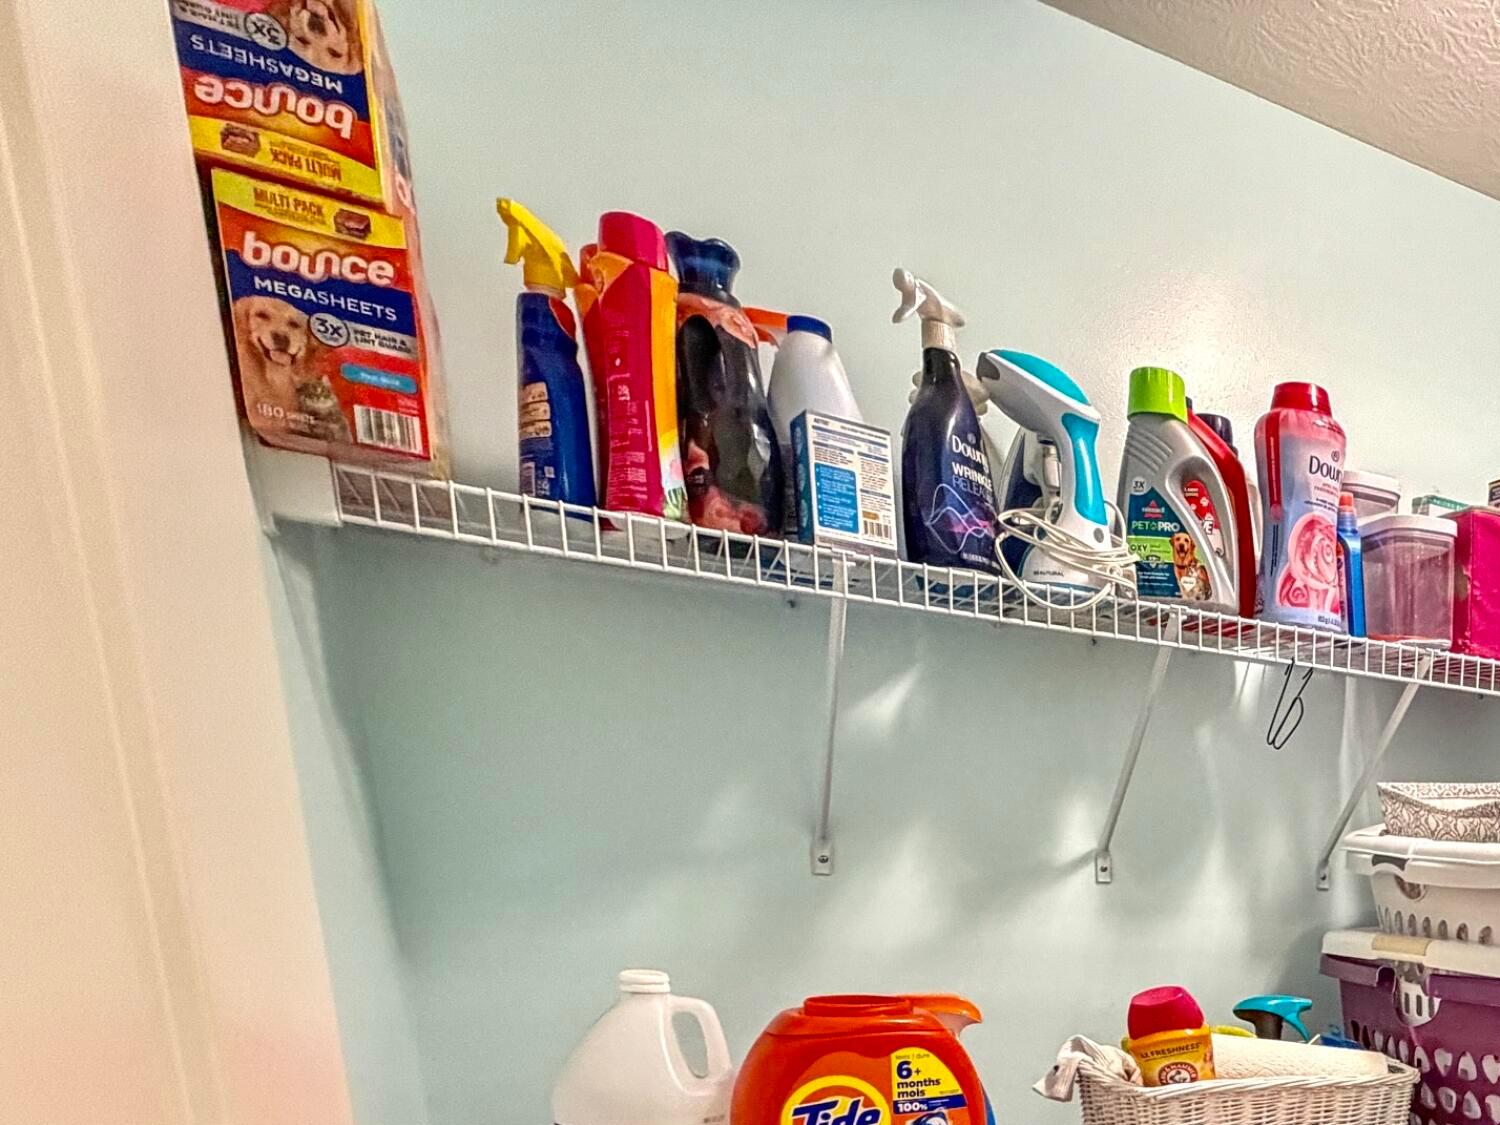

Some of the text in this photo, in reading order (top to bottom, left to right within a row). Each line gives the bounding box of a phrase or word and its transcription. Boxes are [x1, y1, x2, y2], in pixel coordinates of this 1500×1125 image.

[190, 33, 344, 94] MEGASHEETS
[194, 76, 356, 139] bounce
[270, 148, 341, 182] MULTI PACK
[253, 187, 324, 216] MULTI PACK
[242, 231, 395, 286] bounce
[253, 276, 397, 321] MEGASHEETS
[1132, 521, 1180, 532] PET PRO
[1150, 1042, 1201, 1056] FRESHNESS
[897, 1078, 941, 1088] months
[897, 1089, 926, 1098] mois
[897, 1102, 928, 1112] 100%
